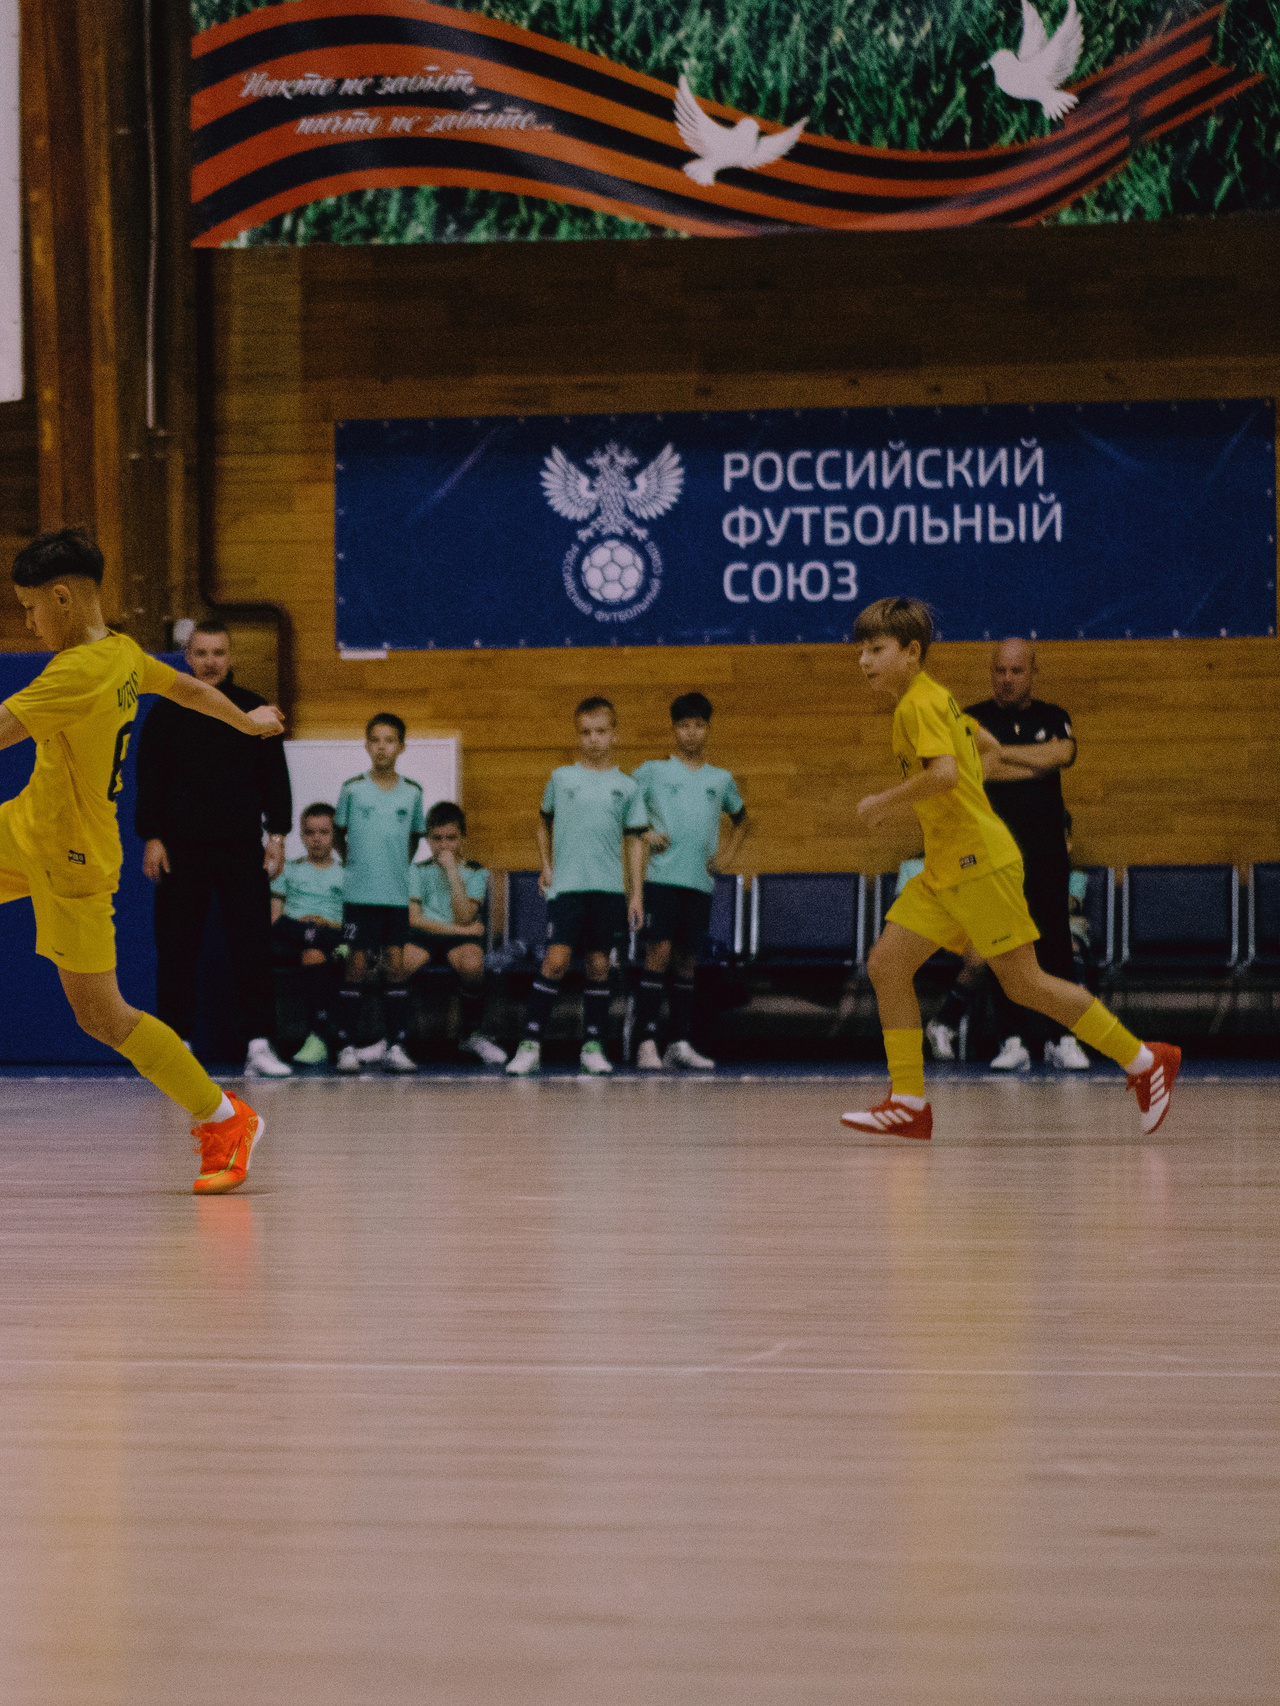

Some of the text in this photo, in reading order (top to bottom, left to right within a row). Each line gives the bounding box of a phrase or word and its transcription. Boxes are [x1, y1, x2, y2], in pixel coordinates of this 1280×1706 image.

[340, 77, 375, 96] не
[388, 115, 422, 133] не
[723, 438, 1044, 492] РОССИЙСКИЙ
[722, 493, 1062, 547] ФУТБОЛЬНЫЙ
[723, 561, 858, 602] СОЮЗ
